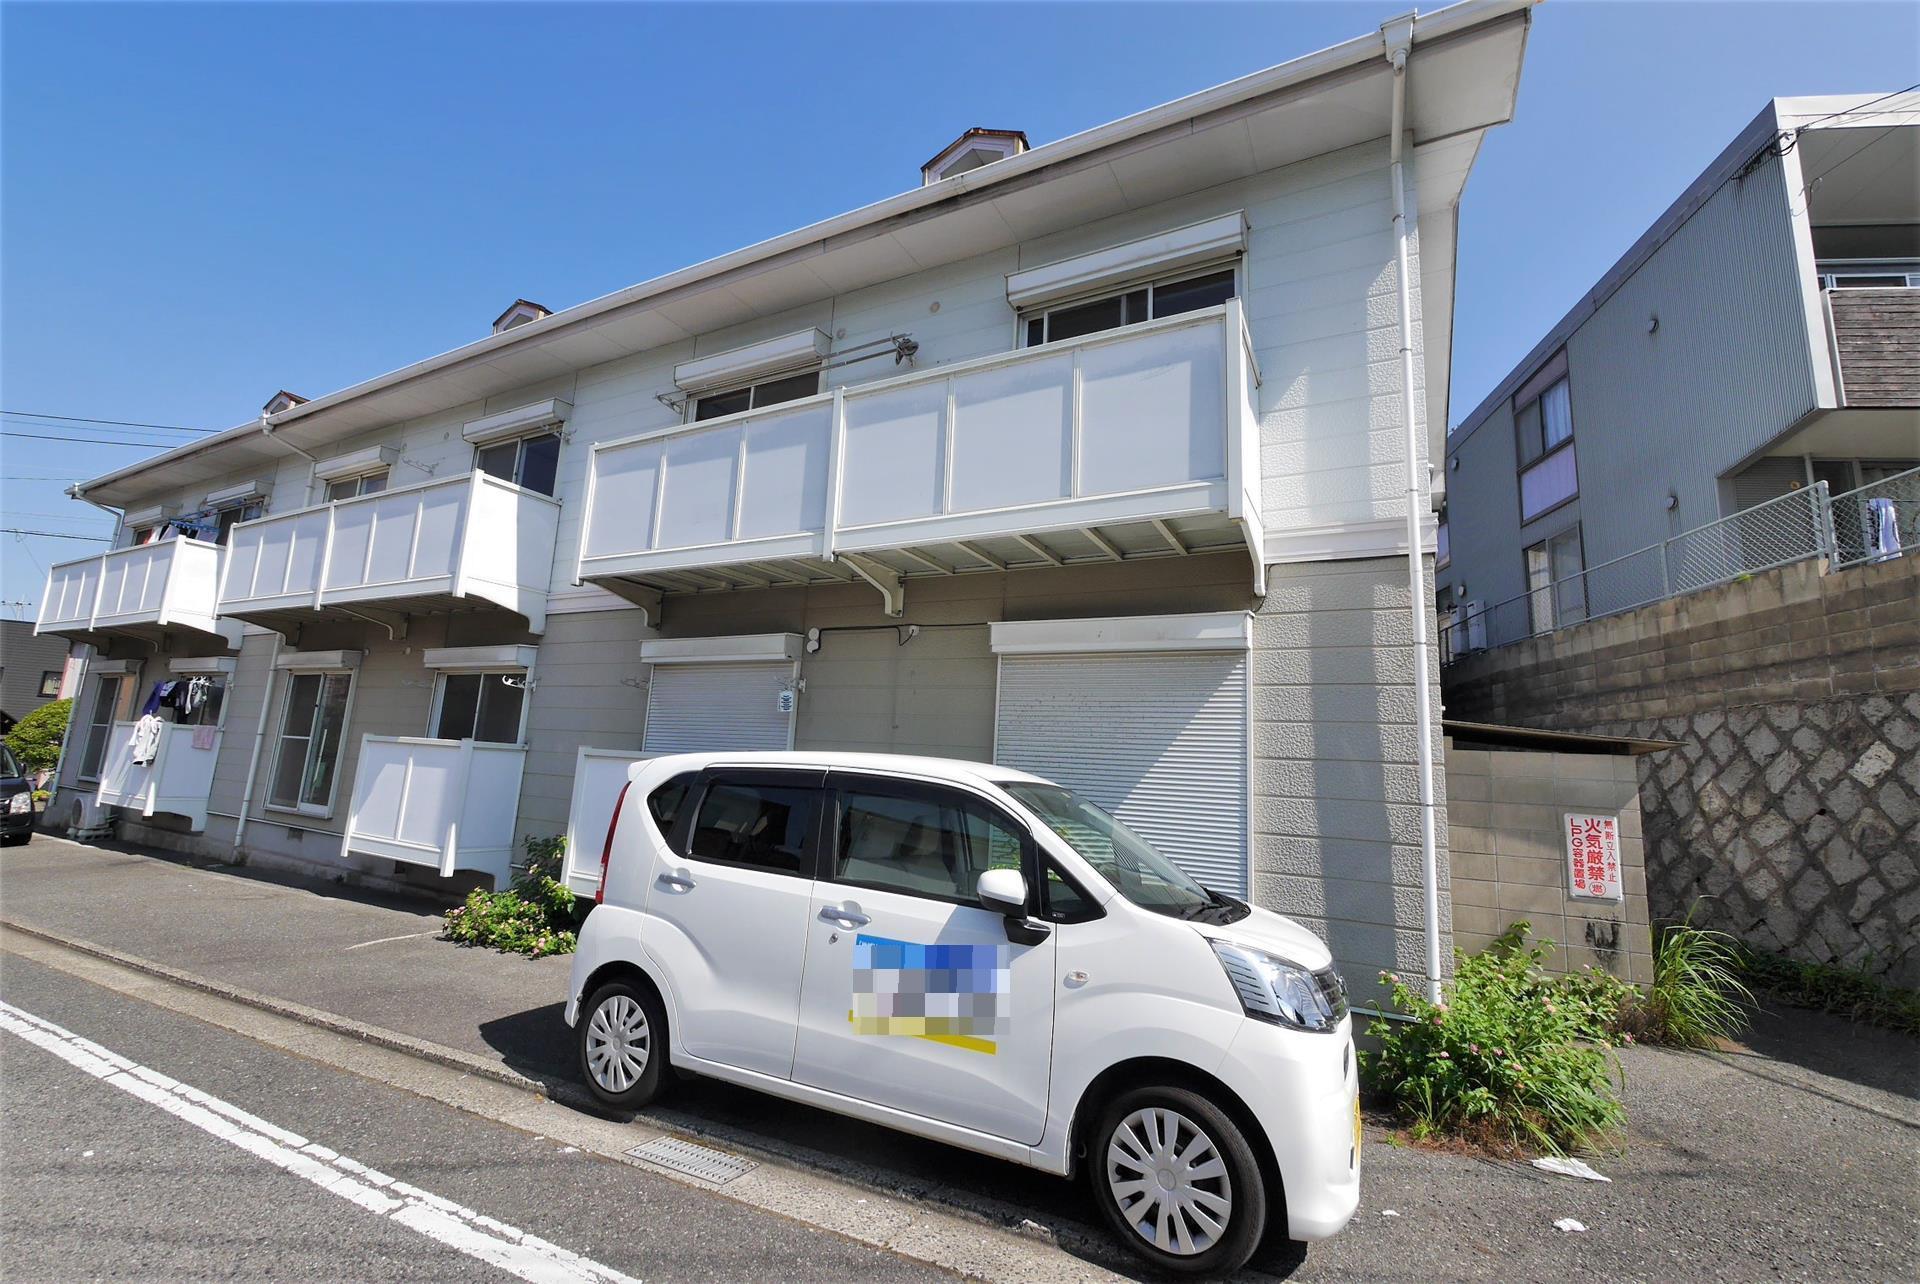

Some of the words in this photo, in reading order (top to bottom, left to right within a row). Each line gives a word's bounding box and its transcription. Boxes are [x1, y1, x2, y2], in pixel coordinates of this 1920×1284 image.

[1570, 817, 1586, 890] LPG容器置場
[1584, 817, 1605, 881] 火気厳禁
[1603, 819, 1617, 883] 無断立入禁止
